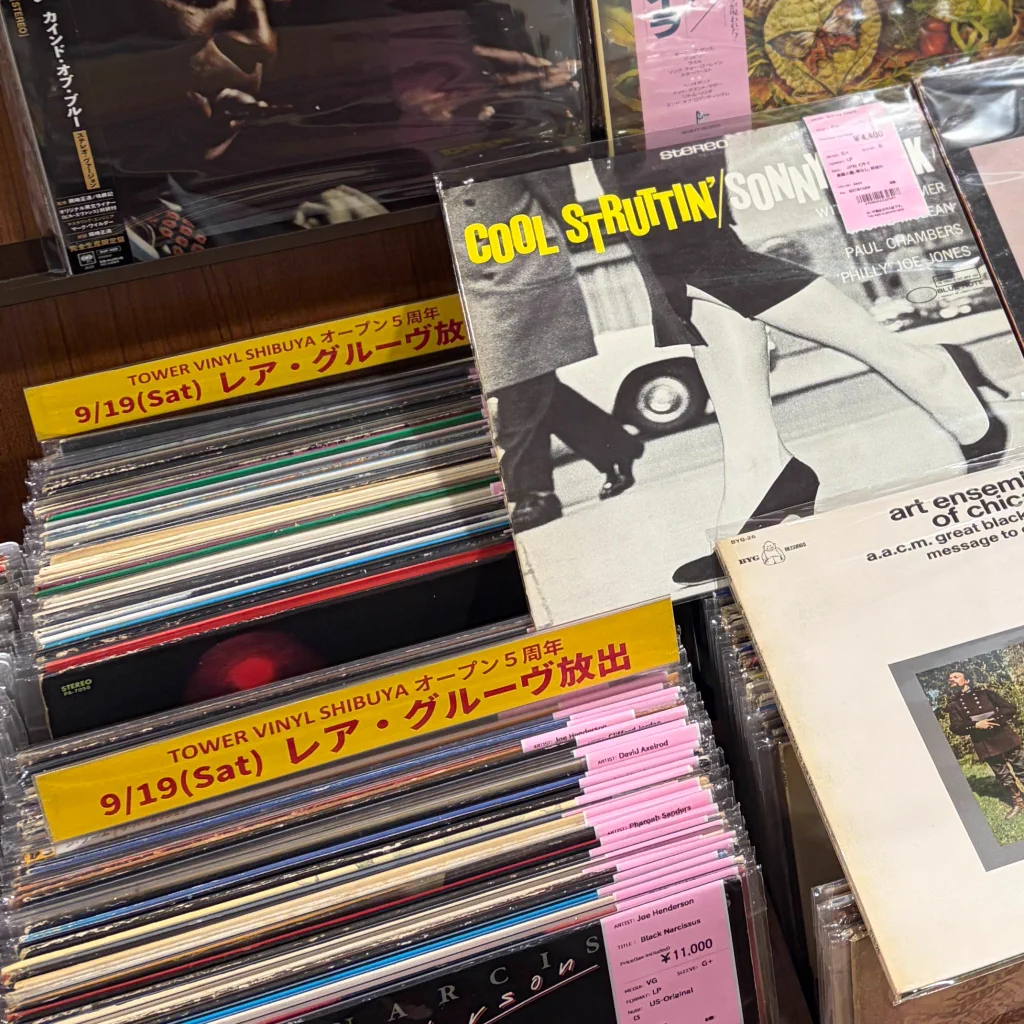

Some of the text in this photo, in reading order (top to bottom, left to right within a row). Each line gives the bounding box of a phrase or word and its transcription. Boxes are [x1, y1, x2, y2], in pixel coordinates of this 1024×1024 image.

[42, 11, 83, 128] カインド・オブ・ブルー
[464, 214, 560, 265] COOL
[845, 223, 965, 259] PAUL CHAMBERS
[896, 256, 923, 273] JOE
[927, 245, 972, 265] JONES
[74, 319, 467, 425] 9/19(Sat) レア・グルーヴ放
[128, 364, 190, 387] TOWER
[193, 354, 243, 372] VINYL
[245, 335, 317, 362] SHIBUYA
[888, 498, 929, 522] art
[932, 506, 961, 528] of
[866, 536, 933, 562] a.a.c.m.
[935, 522, 981, 545] great
[926, 534, 1000, 561] message
[1001, 527, 1018, 540] to
[738, 554, 760, 565] BYG
[61, 678, 92, 692] STEREO
[99, 642, 633, 817] 9/19(Sat) レア・グルーヴ放出
[167, 730, 249, 766] TOWER
[252, 712, 317, 741] VINYL
[318, 683, 410, 723] SHIBUYA
[619, 749, 639, 759] David
[641, 740, 668, 753] Axelrod
[614, 898, 694, 929] ARTIST: Joe Henderson
[640, 931, 662, 943] Black
[663, 919, 701, 935] Narcissus
[660, 938, 713, 963] ¥11,000
[701, 959, 713, 967] G+
[649, 987, 694, 1007] US-Original
[652, 987, 662, 995] LP
